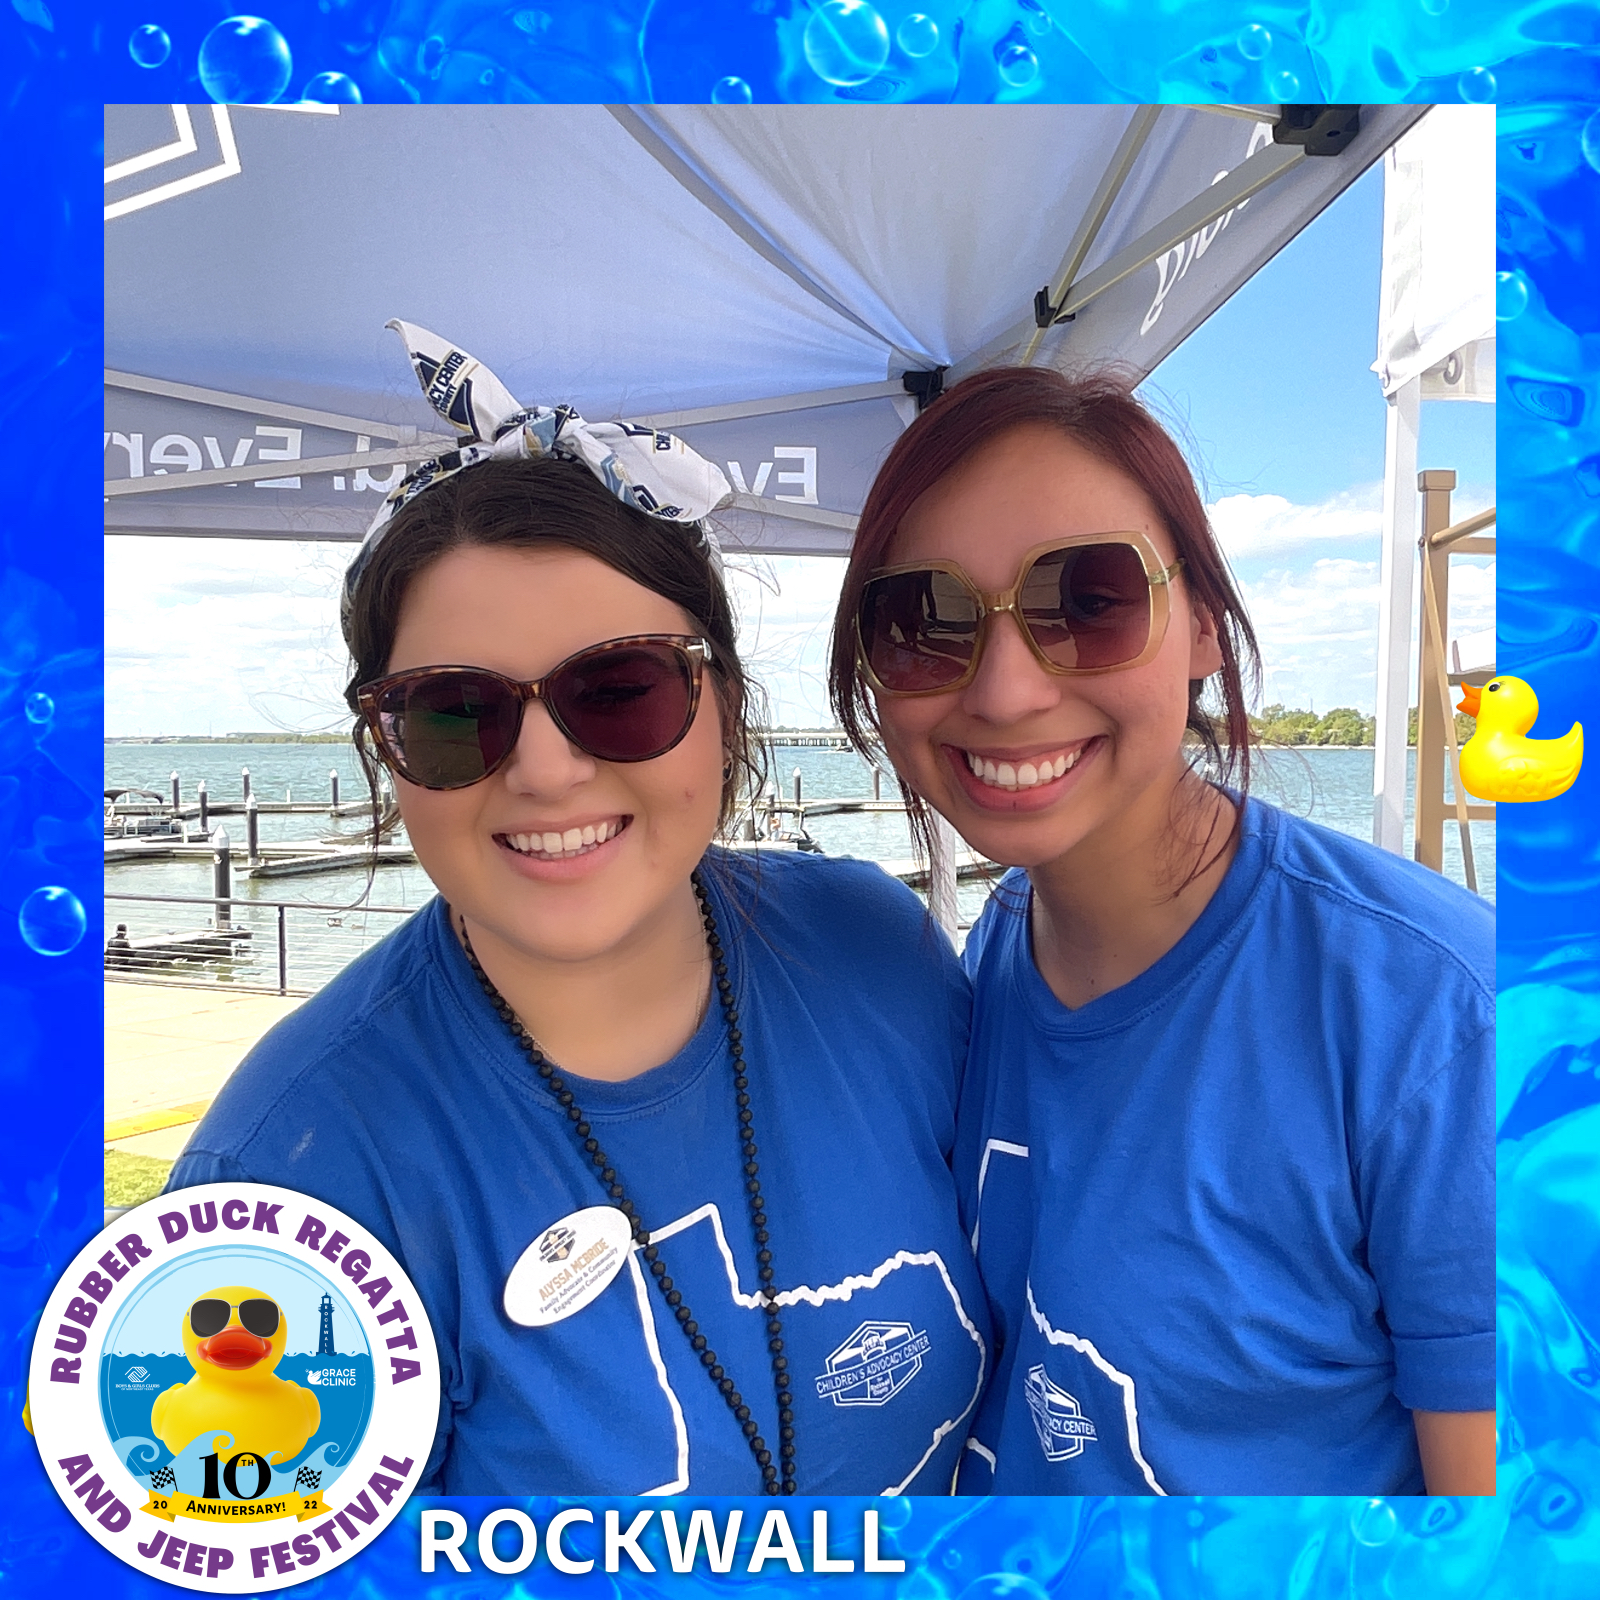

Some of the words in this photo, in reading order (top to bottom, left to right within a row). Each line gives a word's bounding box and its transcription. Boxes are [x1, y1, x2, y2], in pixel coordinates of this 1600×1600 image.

[436, 351, 468, 387] CENTER
[539, 1268, 573, 1301] ALYSSA
[570, 1237, 609, 1274] MCBRIDE
[540, 1296, 560, 1314] Family
[559, 1277, 583, 1299] Advocate
[588, 1247, 618, 1273] Community
[553, 1285, 586, 1314] Engagement
[585, 1260, 616, 1287] Coordinator
[816, 1368, 866, 1394] CHILDREN'S
[866, 1350, 904, 1377] ADVOCACY
[903, 1335, 930, 1359] CENTER
[1063, 1420, 1097, 1436] CENTER
